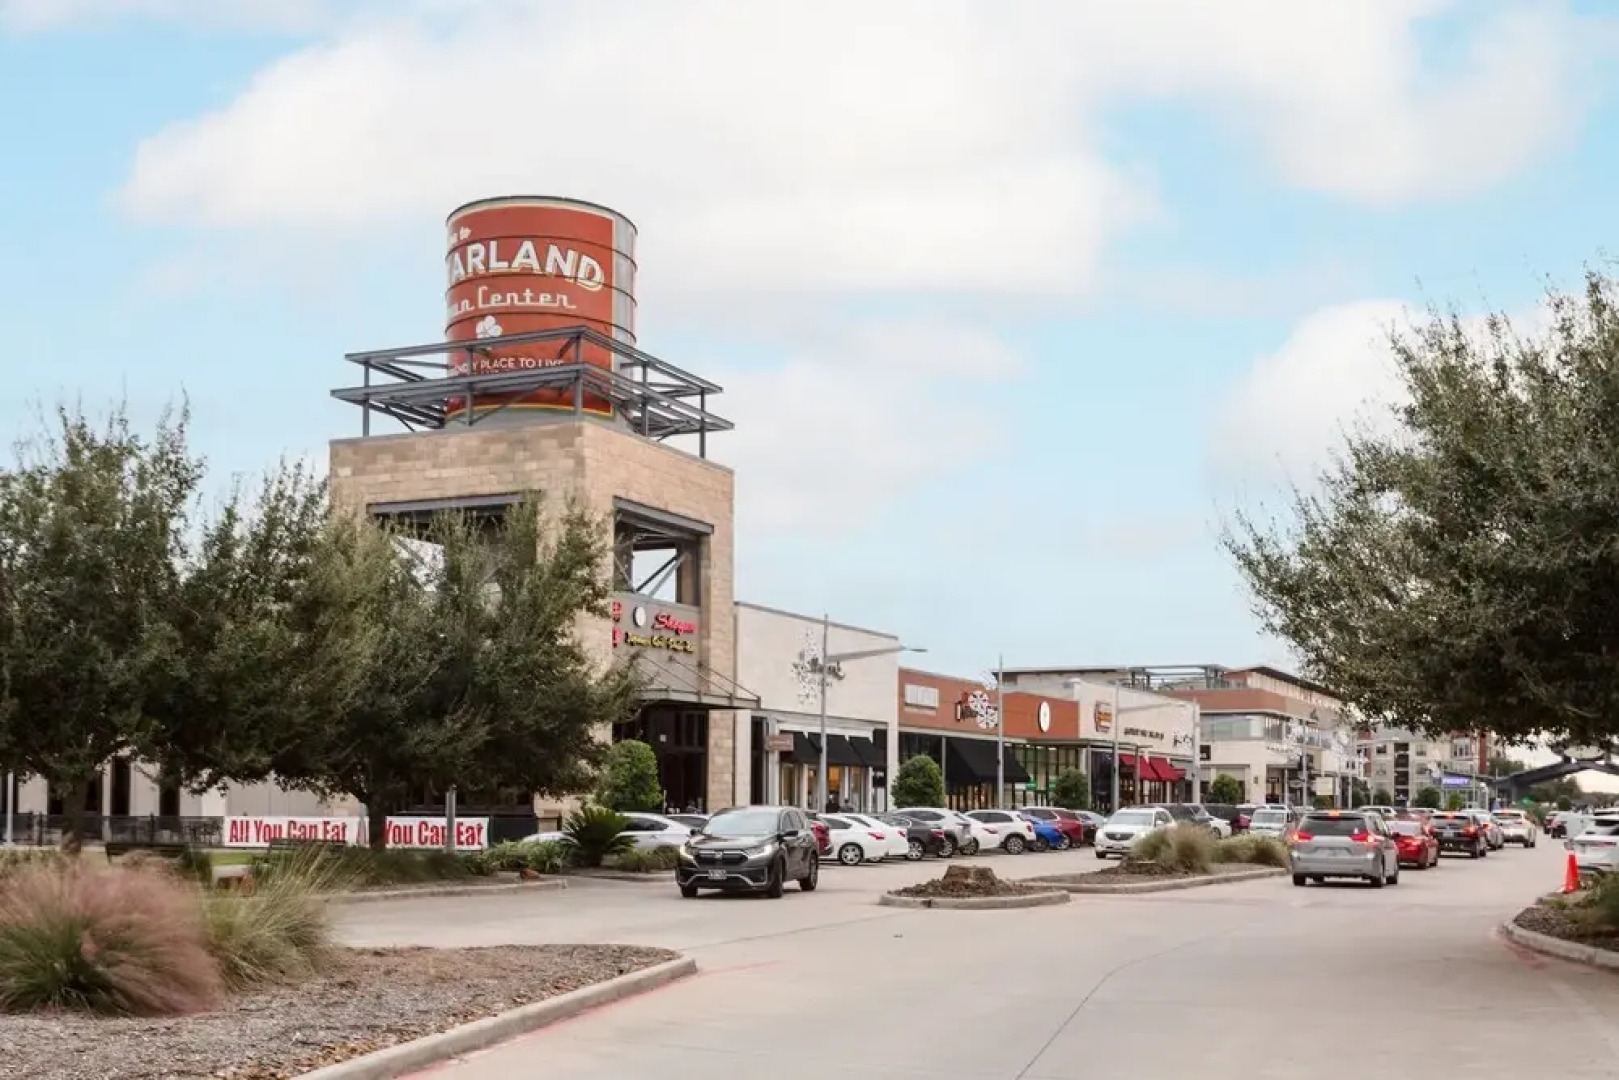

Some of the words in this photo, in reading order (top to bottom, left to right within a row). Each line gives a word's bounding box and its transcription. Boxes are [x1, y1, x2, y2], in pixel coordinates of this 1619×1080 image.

[449, 239, 605, 290] ARLAND
[477, 285, 577, 309] Center
[480, 357, 516, 370] PLACE
[518, 357, 536, 368] TO
[229, 819, 250, 843] All
[254, 819, 283, 843] You
[287, 819, 318, 841] Can
[384, 819, 414, 845] You
[455, 820, 484, 846] Eat
